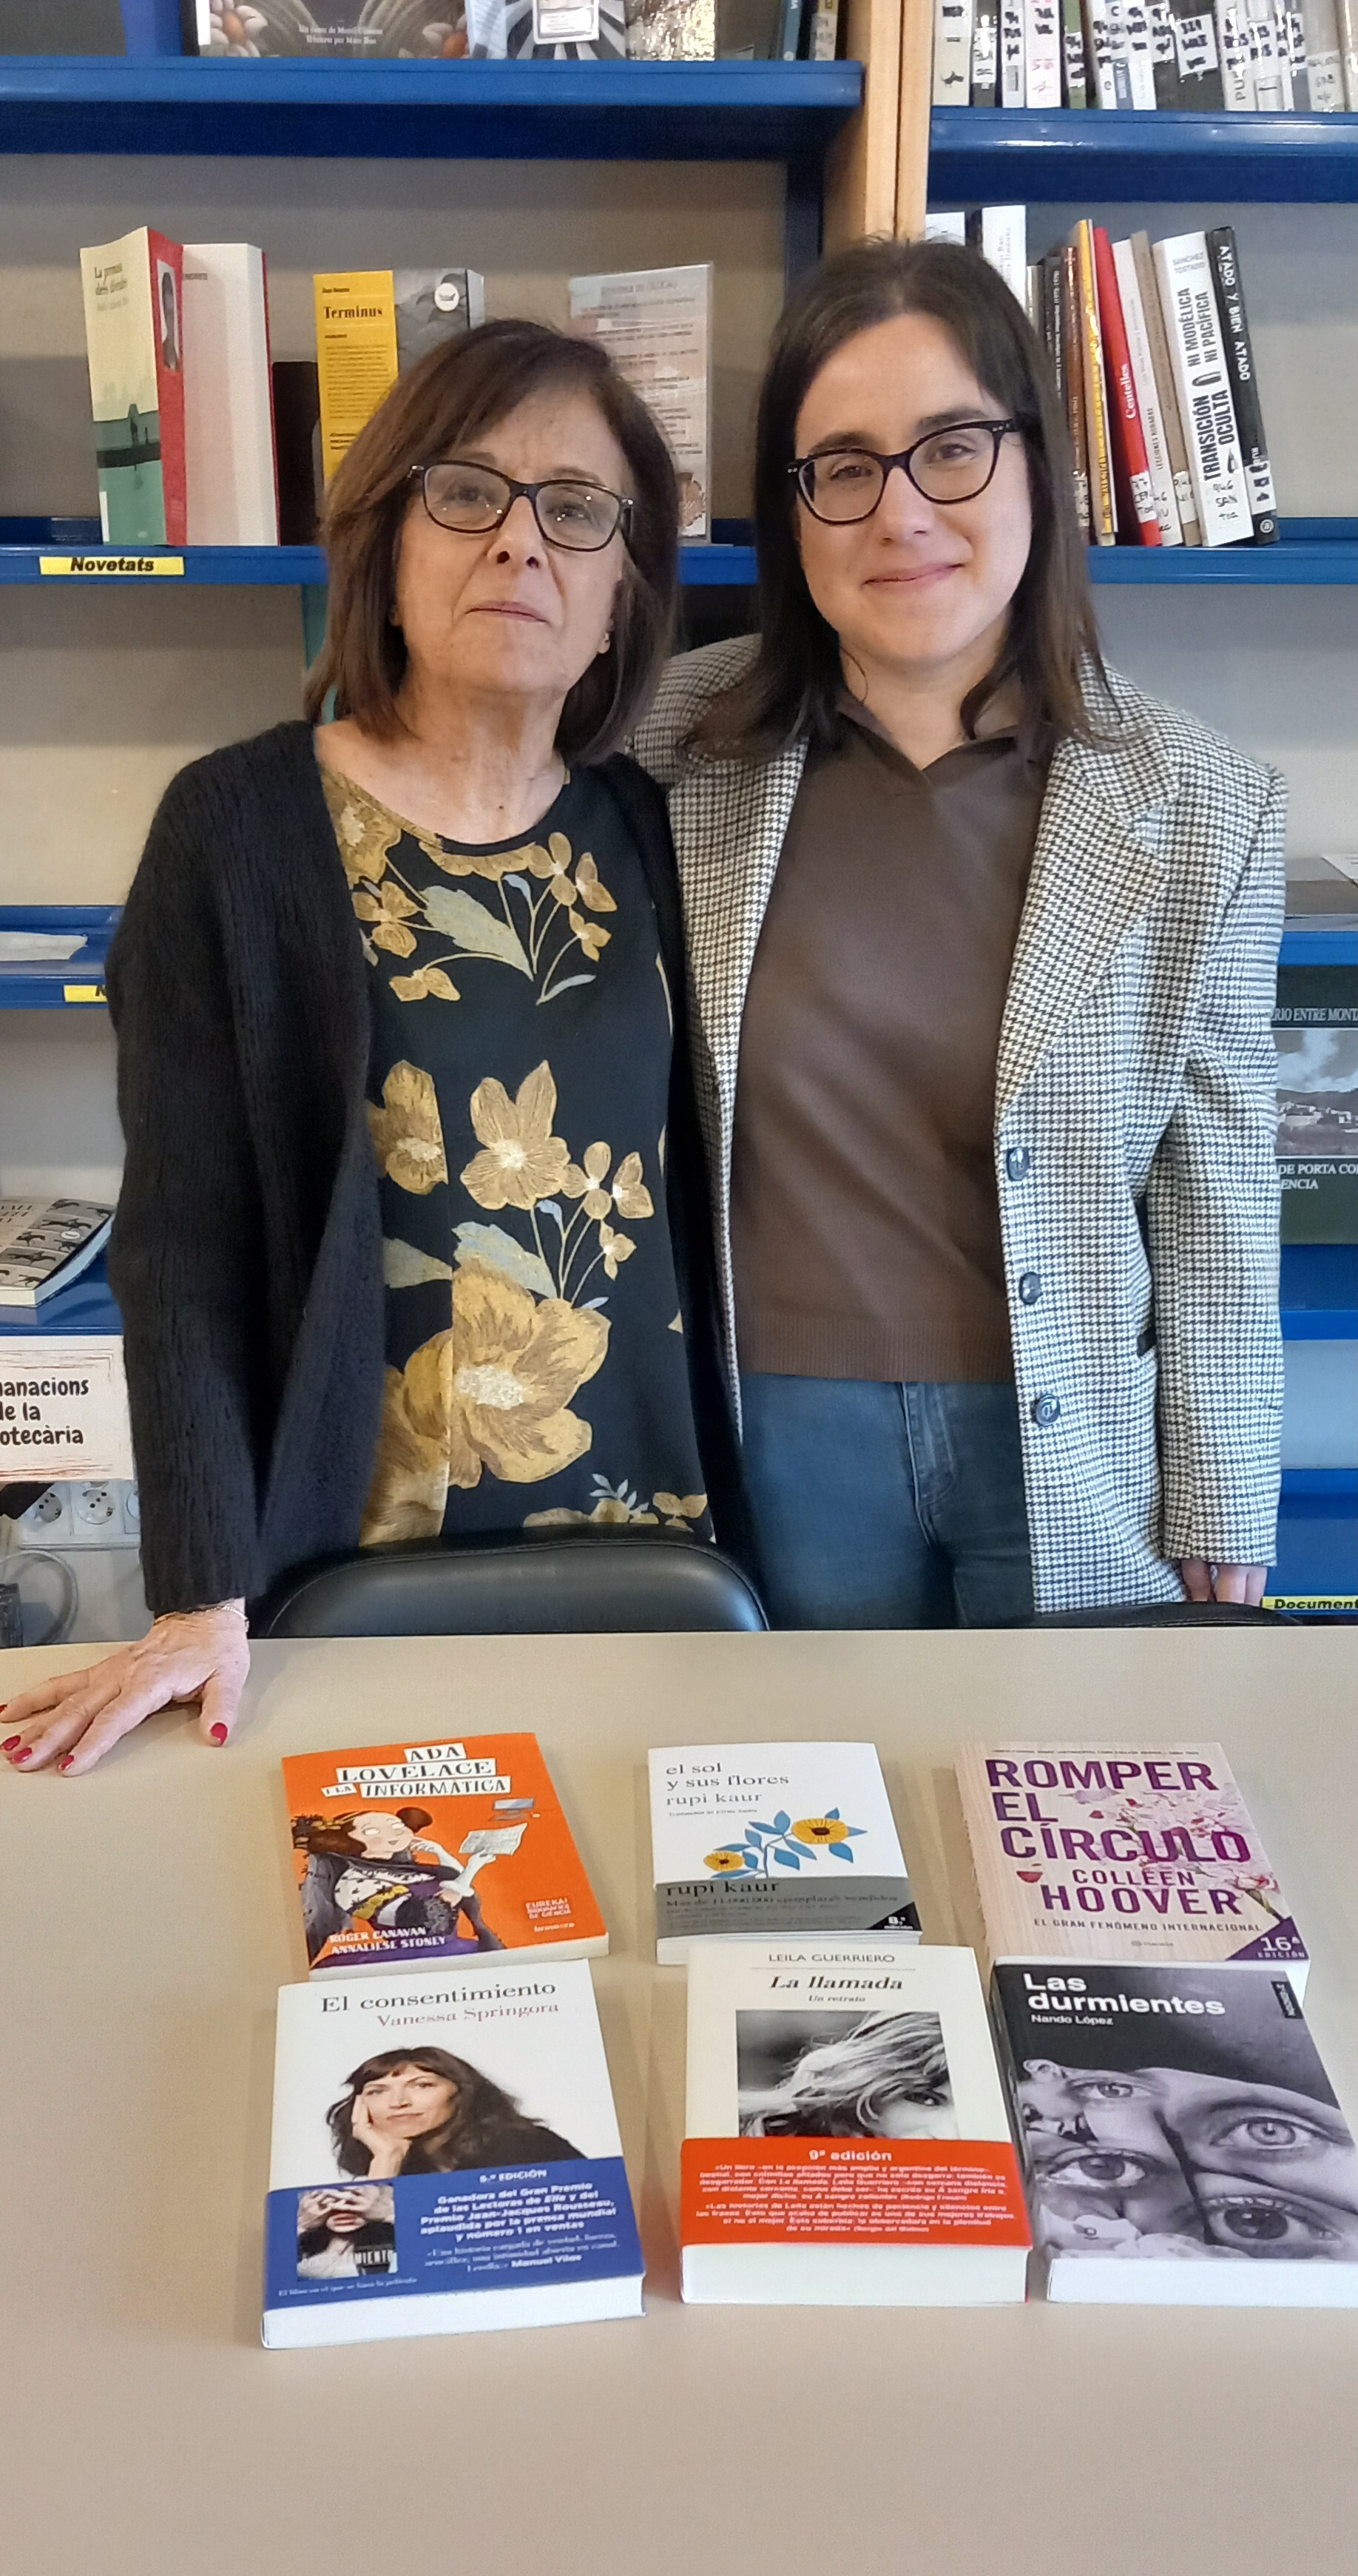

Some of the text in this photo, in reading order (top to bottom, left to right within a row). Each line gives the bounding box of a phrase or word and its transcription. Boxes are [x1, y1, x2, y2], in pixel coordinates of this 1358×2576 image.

[323, 305, 383, 320] Terminus
[1219, 246, 1251, 381] ATADO Y BIEN ATADO
[1177, 287, 1201, 368] NI MODÉLICA
[1195, 291, 1219, 363] NI PACÍFICA
[1119, 363, 1137, 419] Centelles
[1211, 389, 1236, 445] OCULTA
[1192, 394, 1222, 482] TRANSICIÓN
[70, 557, 155, 572] Novetats
[1271, 1008, 1293, 1022] RIO
[1293, 1008, 1327, 1022] ENTRE
[1278, 1163, 1295, 1175] DE
[1297, 1163, 1337, 1175] PORTA
[0, 1377, 89, 1397] anacions
[22, 1402, 41, 1421] la
[410, 1746, 462, 1762] ADA
[342, 1760, 493, 1782] LOVELACE
[666, 1762, 722, 1775] el sol
[984, 1759, 1220, 1791] ROMPER
[335, 1785, 352, 1793] LA
[667, 1775, 790, 1791] y sus flores
[666, 1793, 763, 1807] rupi kaur
[992, 1792, 1058, 1822] EL
[1001, 1823, 1251, 1864] CÍRCULO
[1072, 1869, 1196, 1887] COLLEEN
[666, 1881, 780, 1897] rupi kaur
[1041, 1884, 1243, 1915] HOOVER
[328, 1926, 427, 1943] ROGER CANAVAN
[1034, 1918, 1263, 1932] EL GRAN FENÓMENO INTERNACIONAL
[331, 1936, 447, 1955] ANNALIESE STONEY
[768, 1954, 896, 1963] LEILA GUERRIERO
[770, 1975, 903, 1989] La llamada
[1022, 1972, 1087, 1992] Las
[321, 1983, 556, 2013] El consentimiento
[1028, 1992, 1226, 2015] durmientes
[376, 2003, 559, 2028] Vanessa Springora
[1030, 2014, 1114, 2026] Nando López
[830, 2150, 893, 2162] edición
[499, 2168, 548, 2182] EDICIÓN
[433, 2205, 450, 2214] de
[452, 2203, 470, 2212] las
[472, 2199, 524, 2211] Lectoras
[525, 2196, 541, 2205] de
[569, 2194, 577, 2202] y
[579, 2190, 599, 2199] del
[437, 2182, 593, 2205] Ganadora del Gran Premio
[420, 2199, 615, 2225] Premio Jean-Jacques Rousseau,
[420, 2207, 618, 2235] aplaudida por la prensa mundial
[456, 2233, 465, 2243] y
[466, 2228, 516, 2240] número
[525, 2225, 541, 2234] en
[544, 2220, 585, 2233] ventas
[511, 2253, 582, 2269] Manuel Vilas
